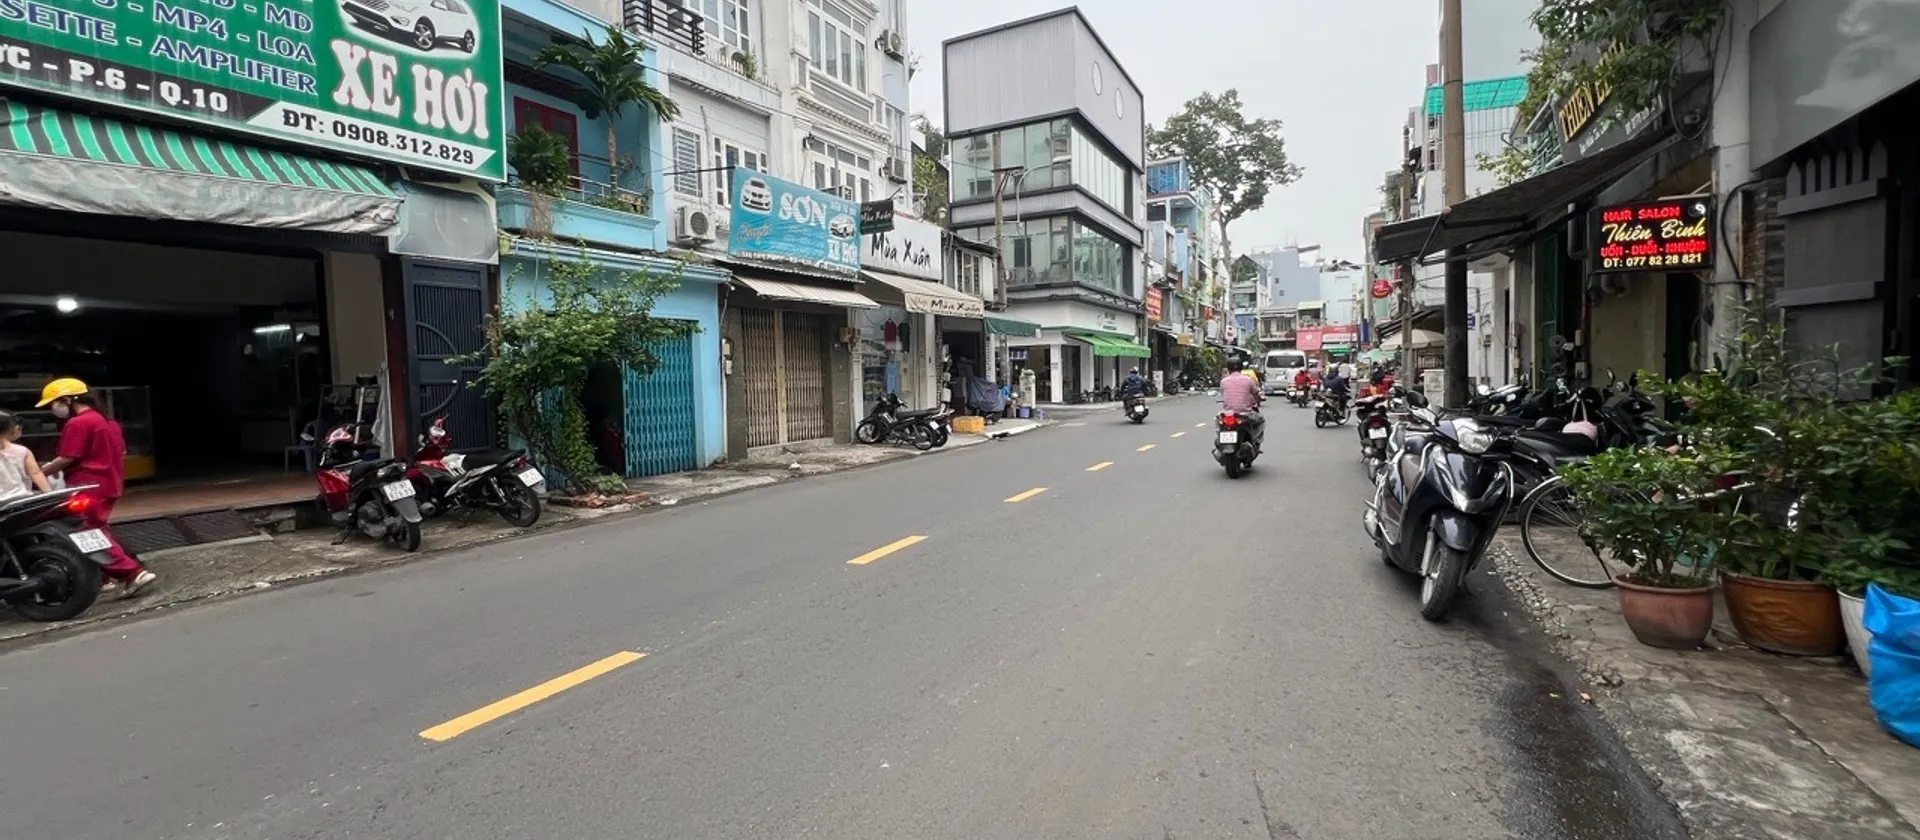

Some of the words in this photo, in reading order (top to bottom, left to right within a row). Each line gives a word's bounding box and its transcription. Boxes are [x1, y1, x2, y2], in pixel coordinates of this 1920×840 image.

[153, 1, 228, 40] MP4
[257, 30, 316, 65] LOA
[264, 2, 313, 33] MD
[150, 34, 318, 95] AMPLIFIER
[69, 58, 126, 90] P.6
[160, 80, 228, 112] Q.10
[331, 39, 400, 118] XE
[411, 64, 489, 139] HƠI
[283, 108, 325, 134] ĐT:
[332, 120, 474, 165] 0908.312.829
[778, 192, 827, 230] SƠN
[1603, 209, 1632, 222] HAIR
[1638, 206, 1680, 220] SALON
[871, 230, 898, 261] Mùa
[903, 238, 932, 268] Xuân
[1601, 223, 1652, 244] Thiên
[1660, 217, 1706, 239] Bình
[1603, 258, 1623, 268] ĐT:
[1625, 257, 1647, 267] 077
[1648, 256, 1662, 265] 82
[1664, 255, 1680, 264] 28
[1681, 254, 1702, 264] 821
